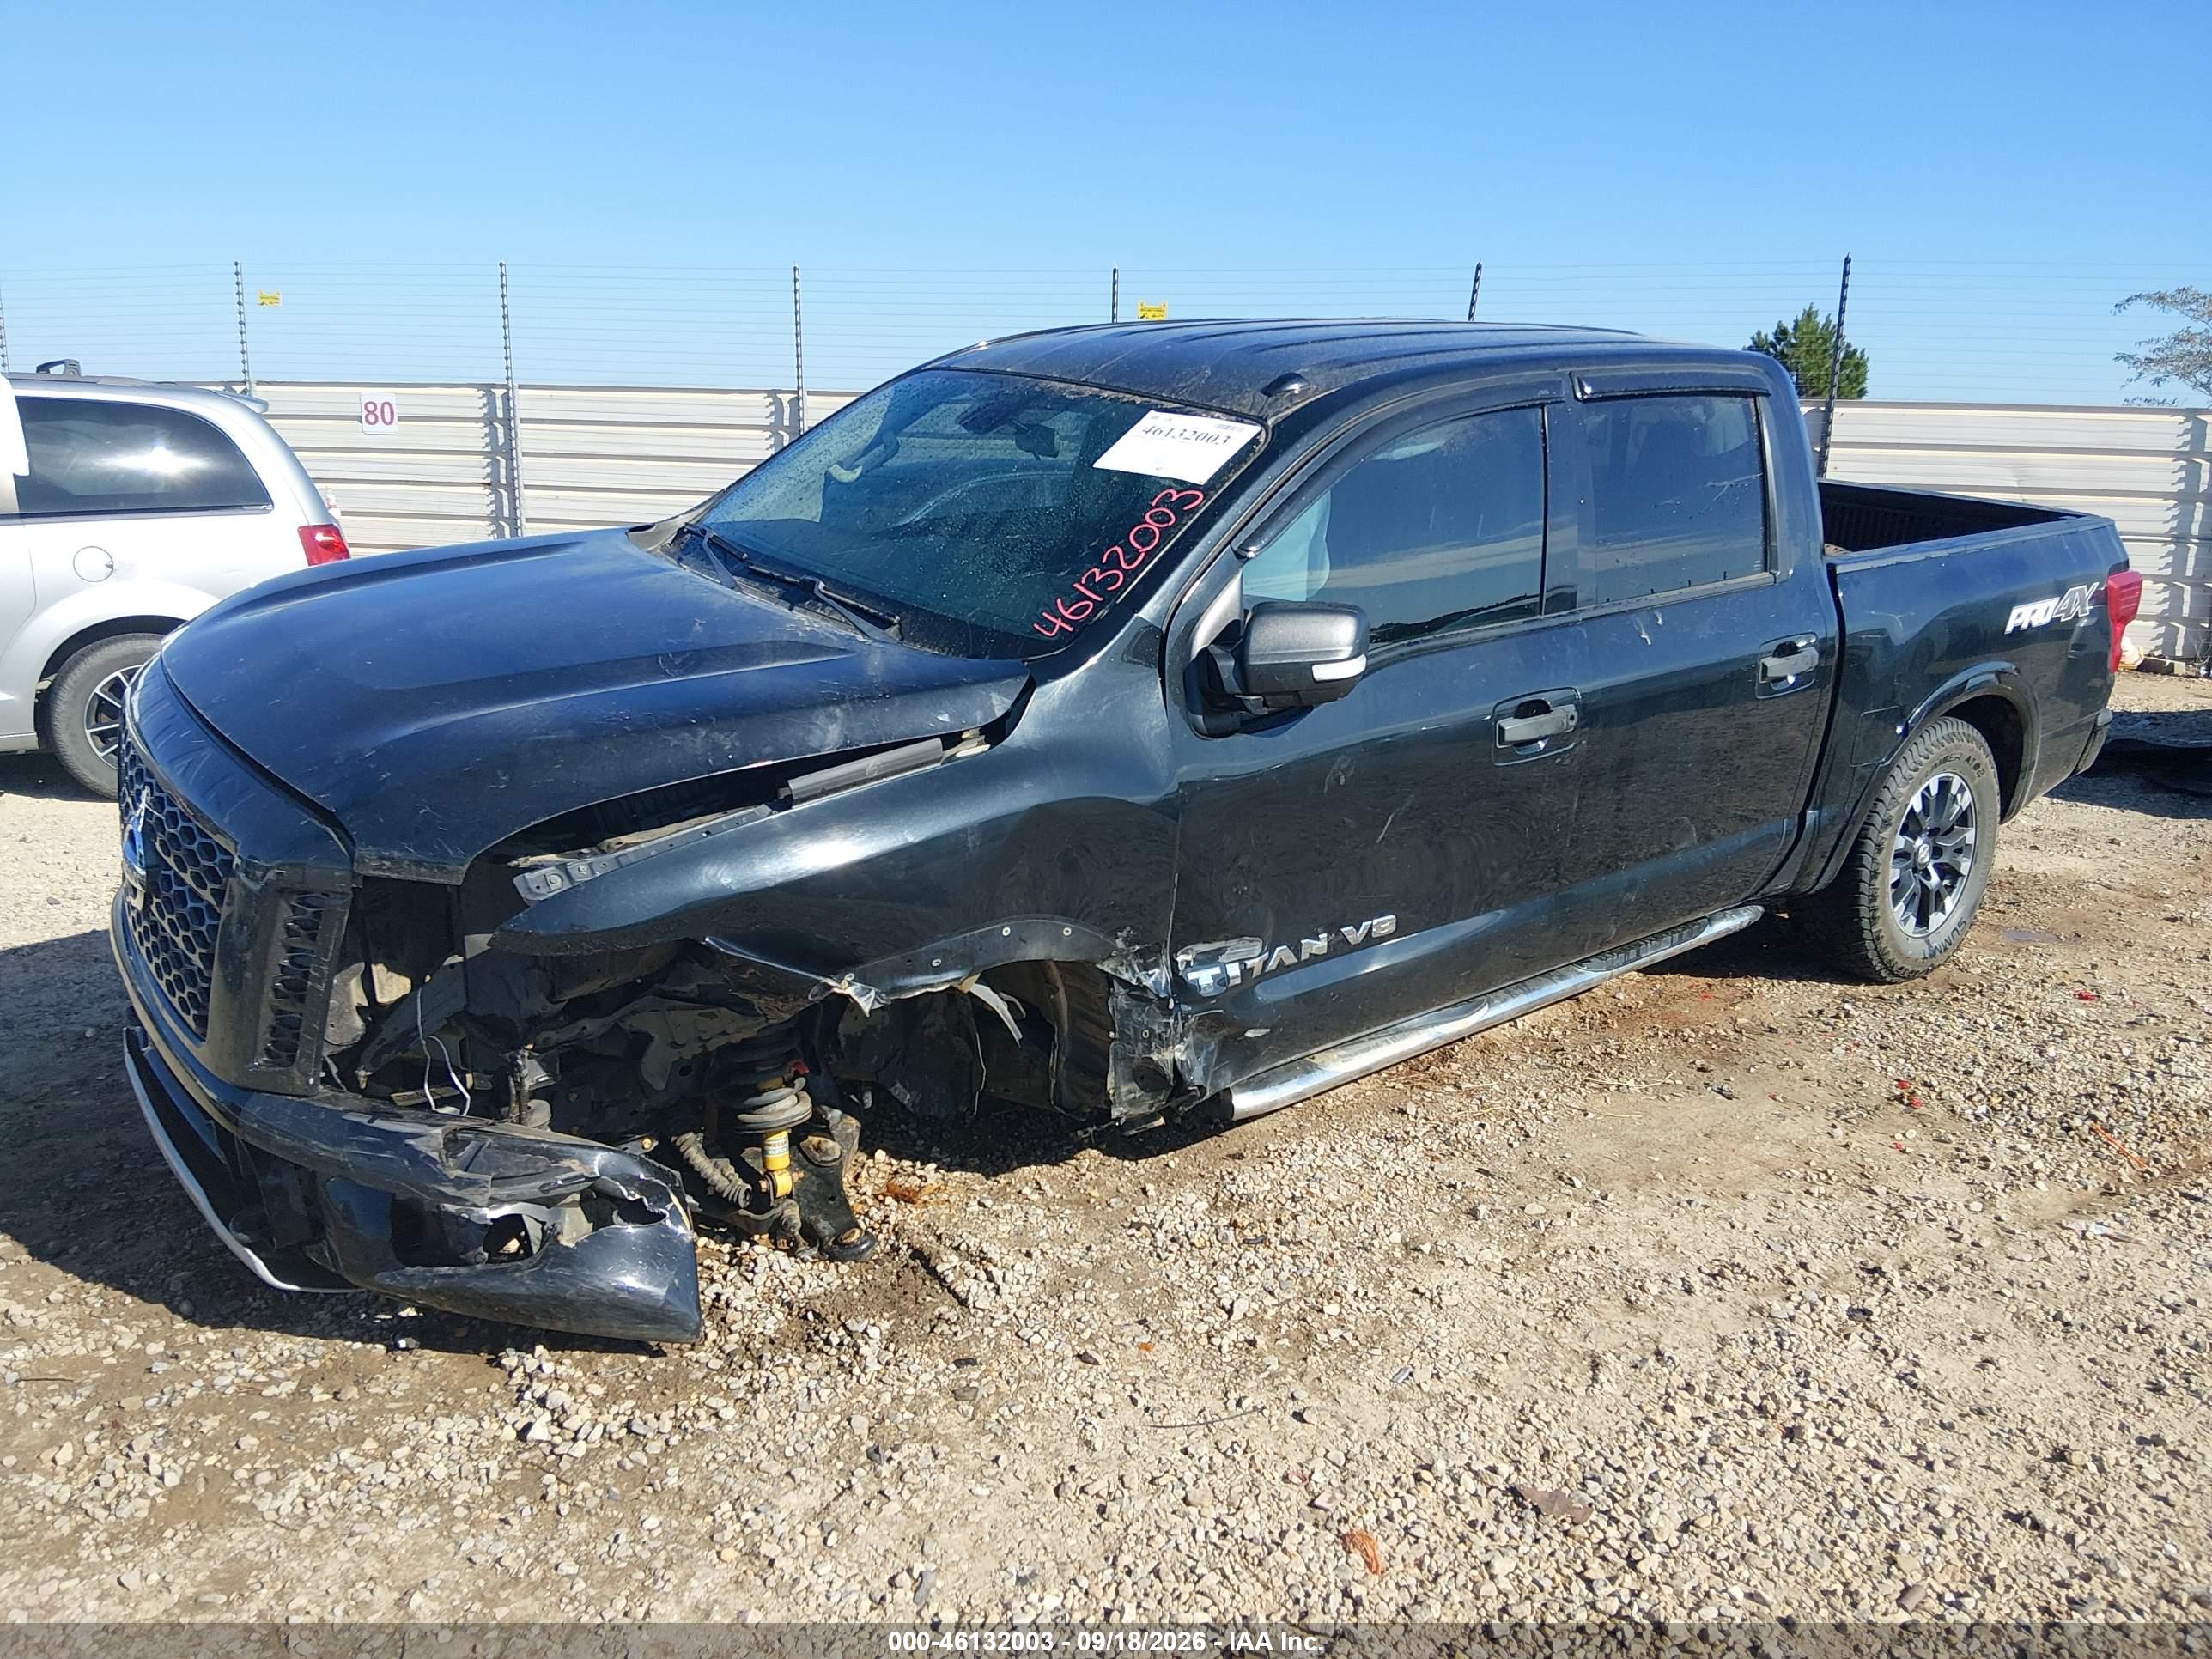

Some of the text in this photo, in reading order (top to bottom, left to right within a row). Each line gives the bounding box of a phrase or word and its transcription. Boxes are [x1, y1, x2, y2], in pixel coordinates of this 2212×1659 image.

[364, 401, 394, 426] 80
[1142, 425, 1231, 446] 46132003
[1033, 488, 1204, 637] 46132003
[1186, 915, 1397, 992] TITAN V8
